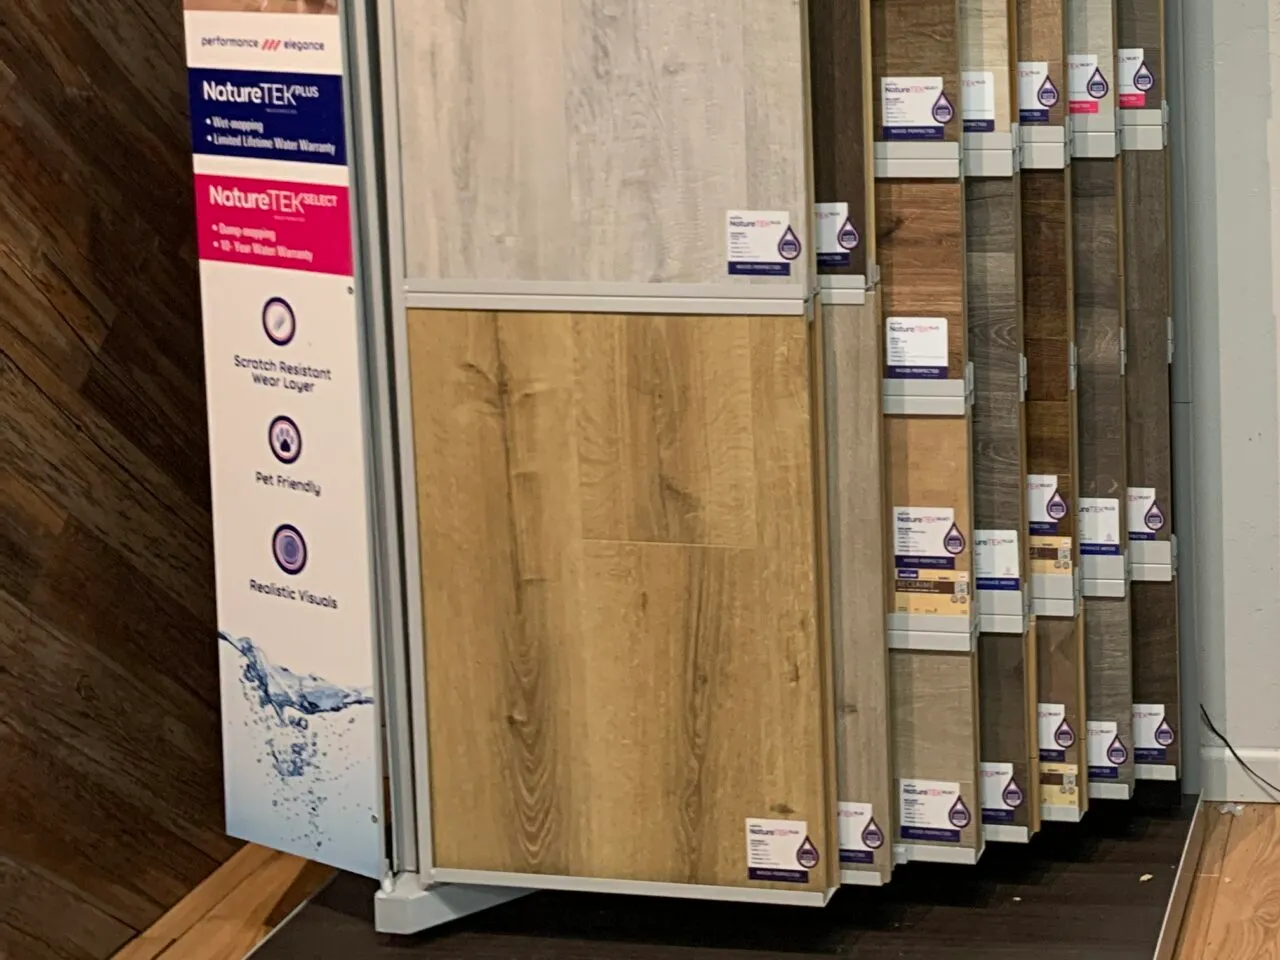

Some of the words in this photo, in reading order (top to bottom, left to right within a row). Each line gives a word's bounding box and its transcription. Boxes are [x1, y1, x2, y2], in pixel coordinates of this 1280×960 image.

[201, 36, 258, 48] performance
[284, 39, 325, 51] elegance
[234, 355, 277, 373] Scratch
[280, 360, 332, 380] Resistant
[252, 373, 280, 387] Wear
[282, 378, 315, 393] Layer
[256, 471, 274, 486] Pet
[277, 475, 321, 497] Friendly
[250, 579, 296, 602] Realistic
[298, 590, 338, 610] Visuals
